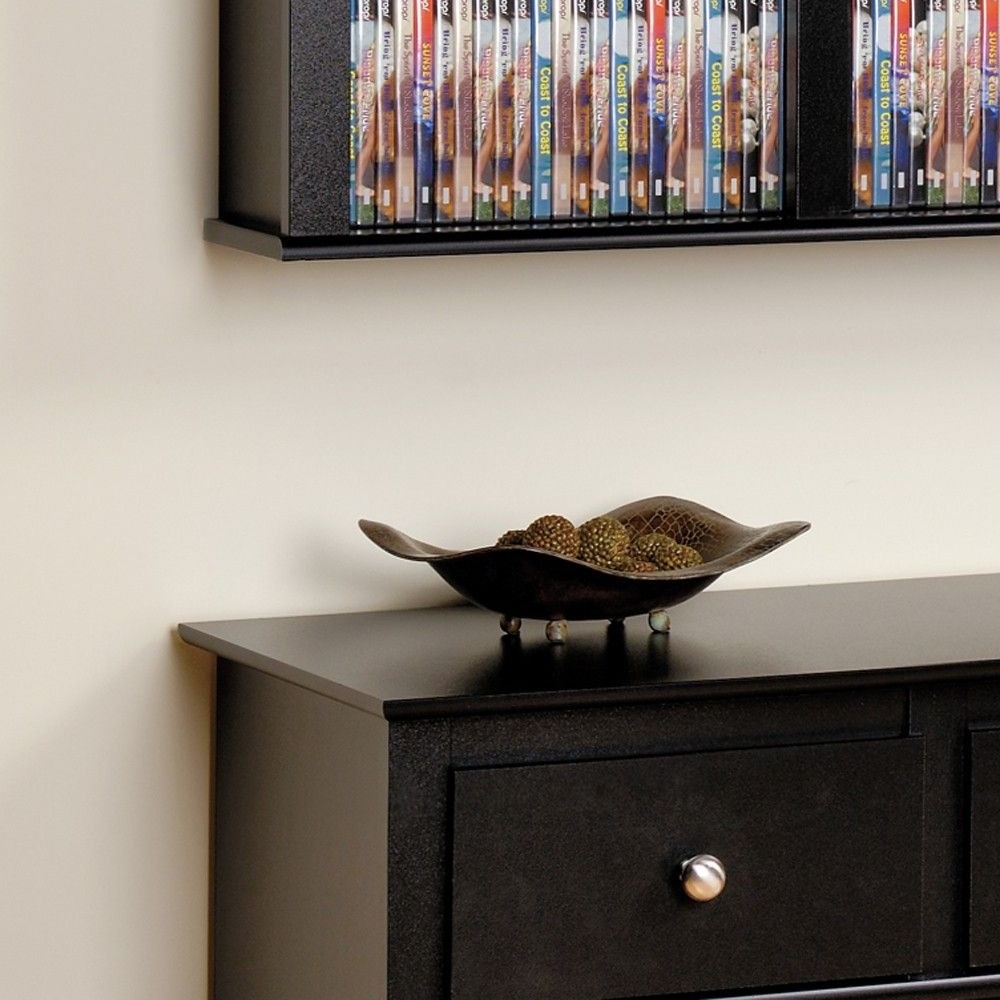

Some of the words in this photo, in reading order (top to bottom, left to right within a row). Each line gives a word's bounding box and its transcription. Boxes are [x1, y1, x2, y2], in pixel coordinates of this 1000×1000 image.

[540, 66, 552, 100] Coast
[618, 63, 628, 97] Coast
[712, 59, 724, 94] Coast
[880, 58, 891, 92] Coast
[540, 121, 552, 154] Coast
[618, 118, 628, 152] Coast
[712, 115, 722, 149] Coast
[880, 112, 891, 145] Coast
